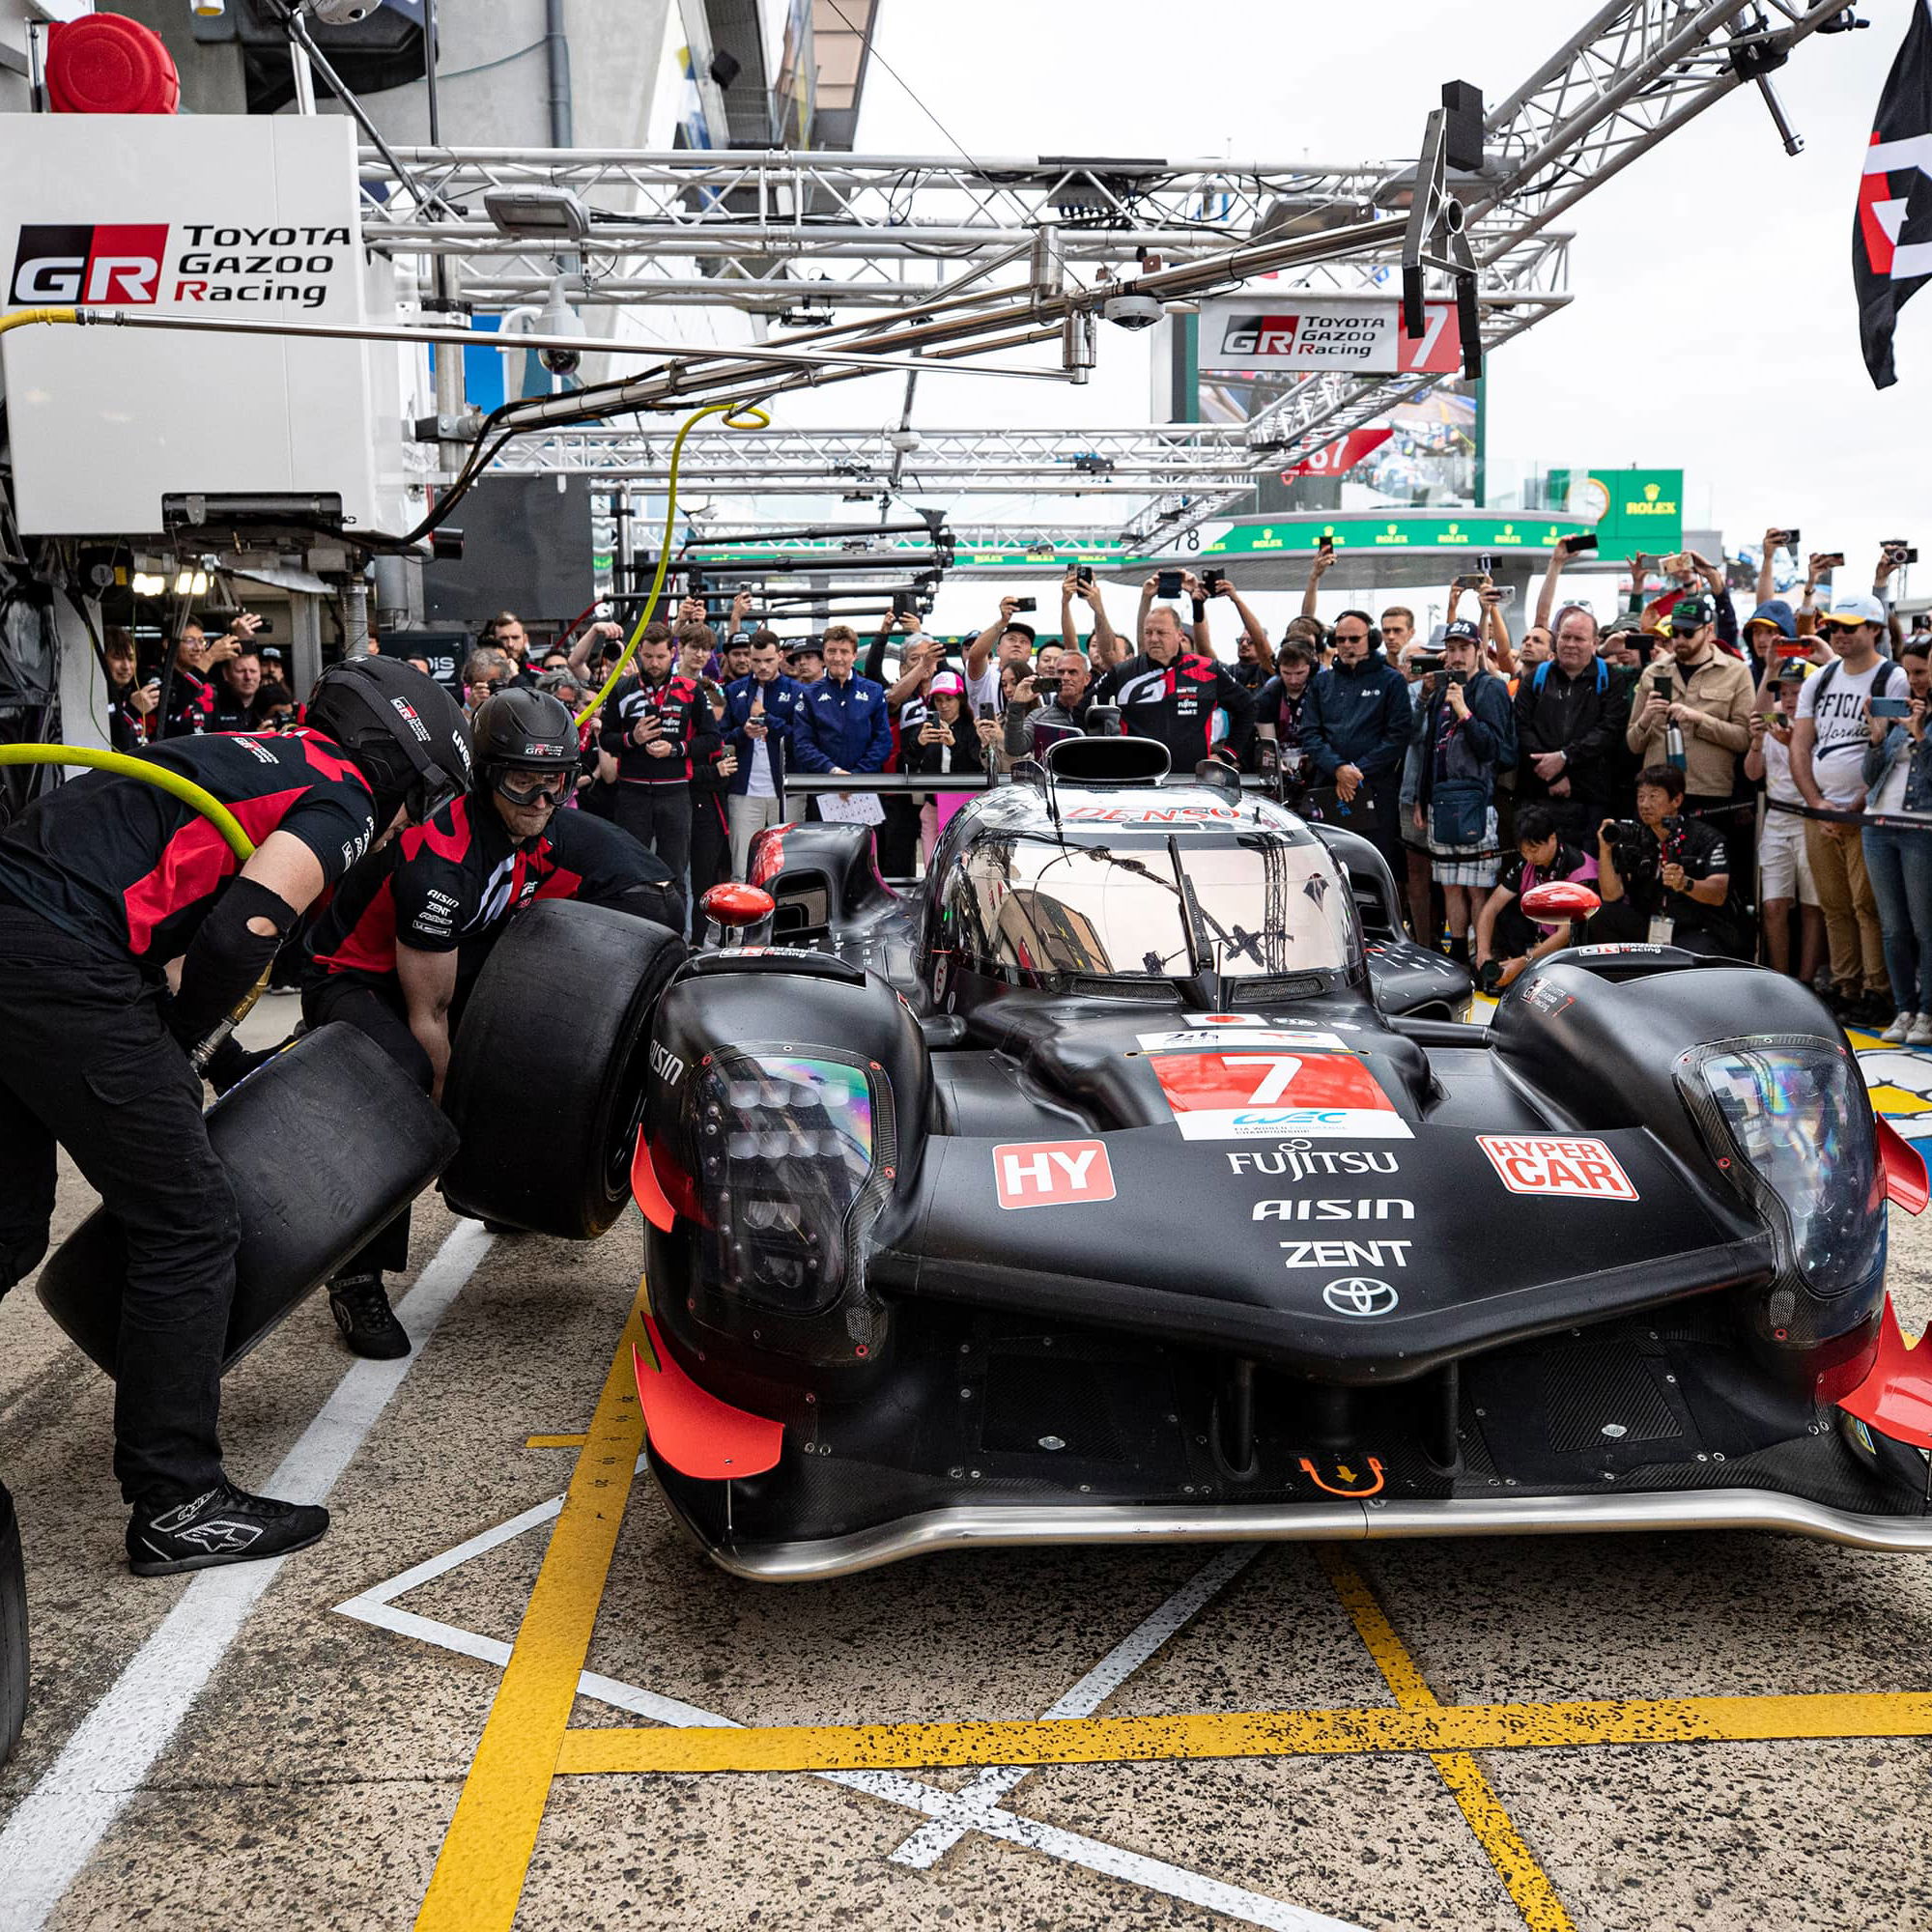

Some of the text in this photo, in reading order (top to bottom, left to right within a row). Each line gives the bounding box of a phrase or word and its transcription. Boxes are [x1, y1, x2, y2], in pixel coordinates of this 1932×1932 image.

[183, 225, 351, 246] TOYOTA
[179, 253, 333, 274] GAZOO
[14, 257, 159, 301] GR
[174, 280, 327, 308] Racing
[1304, 316, 1384, 328] TOYOTA
[1224, 330, 1293, 354] GR
[1301, 329, 1376, 341] GAZOO
[1409, 305, 1448, 368] 7
[1297, 343, 1372, 358] Racing
[1626, 501, 1677, 515] ROLEX
[1312, 536, 1345, 546] REX
[1375, 534, 1407, 544] ROLEX
[1437, 534, 1468, 544] ROLEX
[1066, 807, 1240, 821] DENSO
[426, 901, 451, 917] ZENT
[427, 890, 459, 908] AISIN
[1221, 1056, 1303, 1104] 7
[1233, 1112, 1347, 1124] WEC
[1491, 1141, 1605, 1160] HYPER
[1003, 1150, 1098, 1195] HY
[1226, 1151, 1400, 1181] FUJITSU
[1506, 1157, 1624, 1191] CAR
[1252, 1199, 1415, 1220] AISIN
[1279, 1240, 1412, 1267] ZENT
